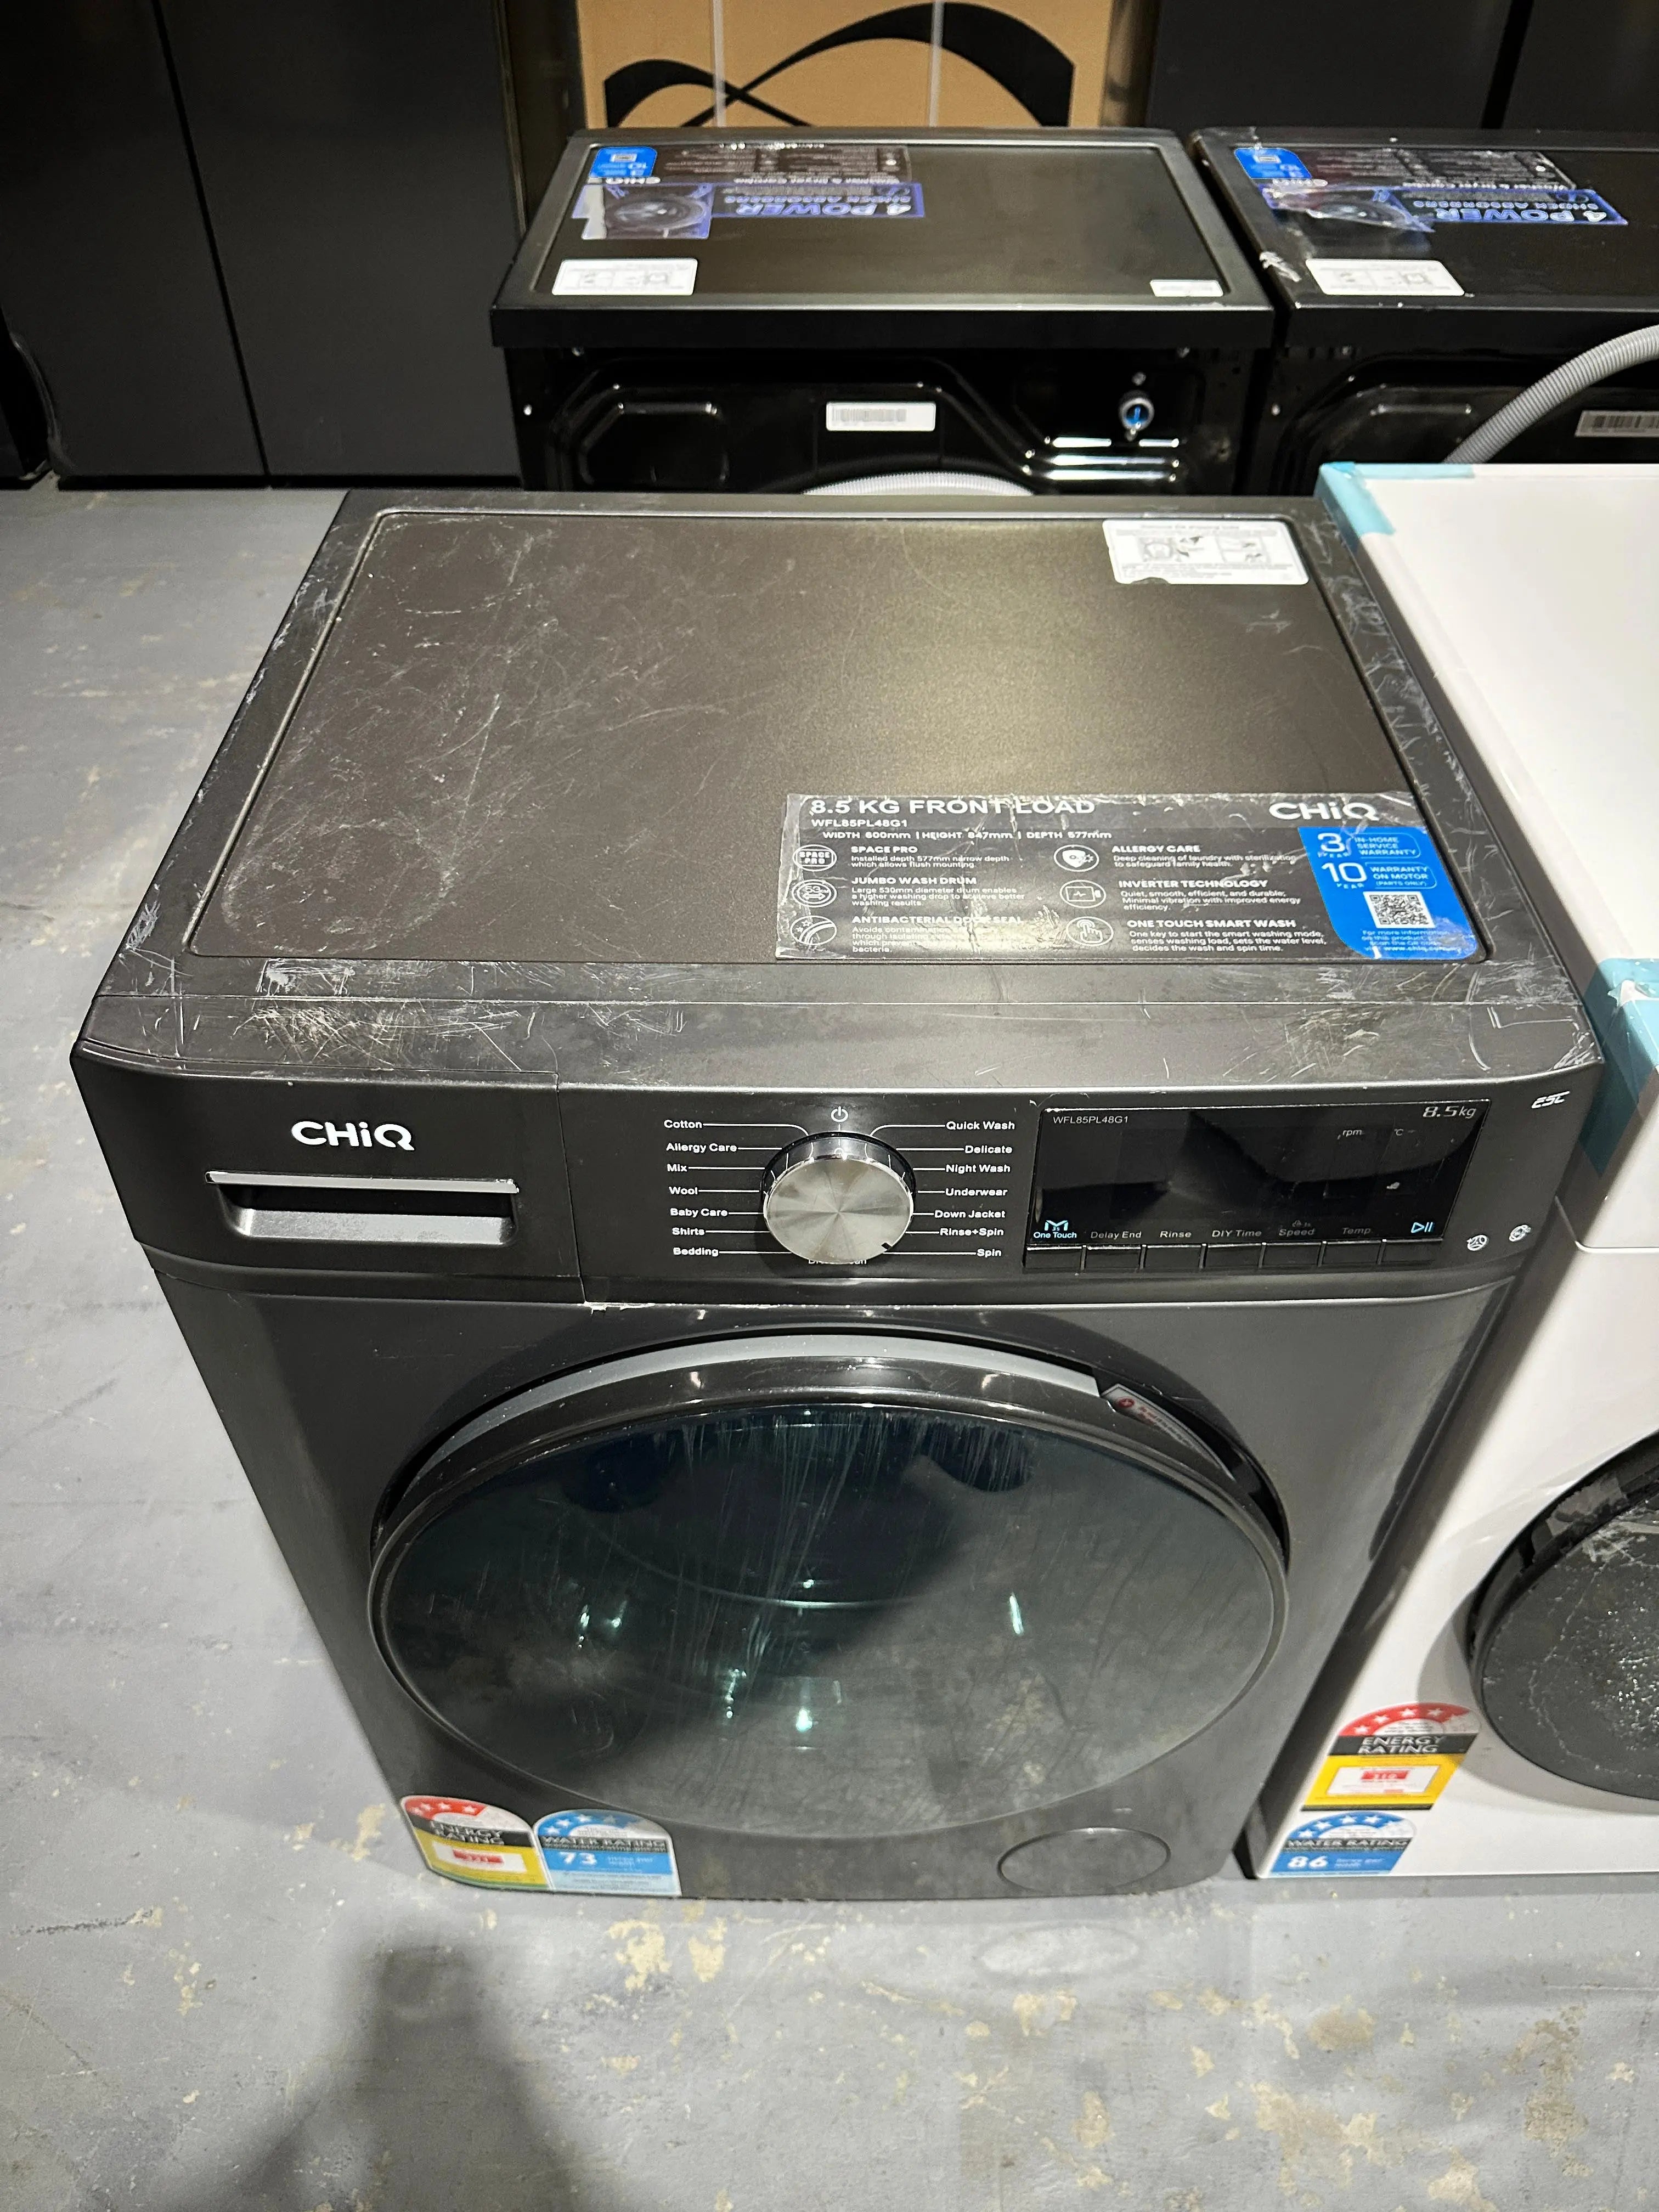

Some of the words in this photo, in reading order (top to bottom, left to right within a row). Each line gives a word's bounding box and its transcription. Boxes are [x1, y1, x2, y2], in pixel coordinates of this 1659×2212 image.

[736, 204, 877, 216] POWER
[1435, 209, 1575, 222] POWER
[811, 800, 850, 814] 8.5
[859, 800, 900, 814] KG
[910, 800, 1007, 814] FRONT
[1015, 800, 1095, 814] LOAD
[1318, 833, 1345, 852] 3
[1322, 862, 1367, 882] 10
[664, 1120, 702, 1128] Cotton
[946, 1121, 980, 1130] Quick
[983, 1121, 1015, 1130] Wash
[291, 1121, 415, 1151] CHiQ
[666, 1143, 707, 1153] Allergy
[709, 1143, 737, 1152] Care
[964, 1146, 1013, 1154] Delicate
[667, 1164, 687, 1172] Mix
[946, 1165, 977, 1174] Night
[669, 1187, 698, 1195] Wool
[670, 1208, 698, 1218] Baby
[701, 1208, 728, 1216] Care
[934, 1210, 966, 1218] Down
[968, 1210, 1006, 1218] Jacket
[672, 1227, 705, 1235] Shirts
[940, 1228, 1004, 1237] Rinse+Spin
[1091, 1231, 1120, 1240] Delay
[1279, 1228, 1315, 1237] Speed
[673, 1247, 719, 1257] Bedding
[977, 1249, 1002, 1258] Spin
[1362, 1736, 1446, 1746] ENERGY
[1358, 1745, 1440, 1754] RATING
[430, 1821, 503, 1838] ENERGY
[435, 1828, 505, 1846] RATING
[1287, 1839, 1342, 1847] WATER
[1346, 1839, 1410, 1847] RATING
[559, 1852, 597, 1865] 73
[1287, 1855, 1328, 1869] 86
